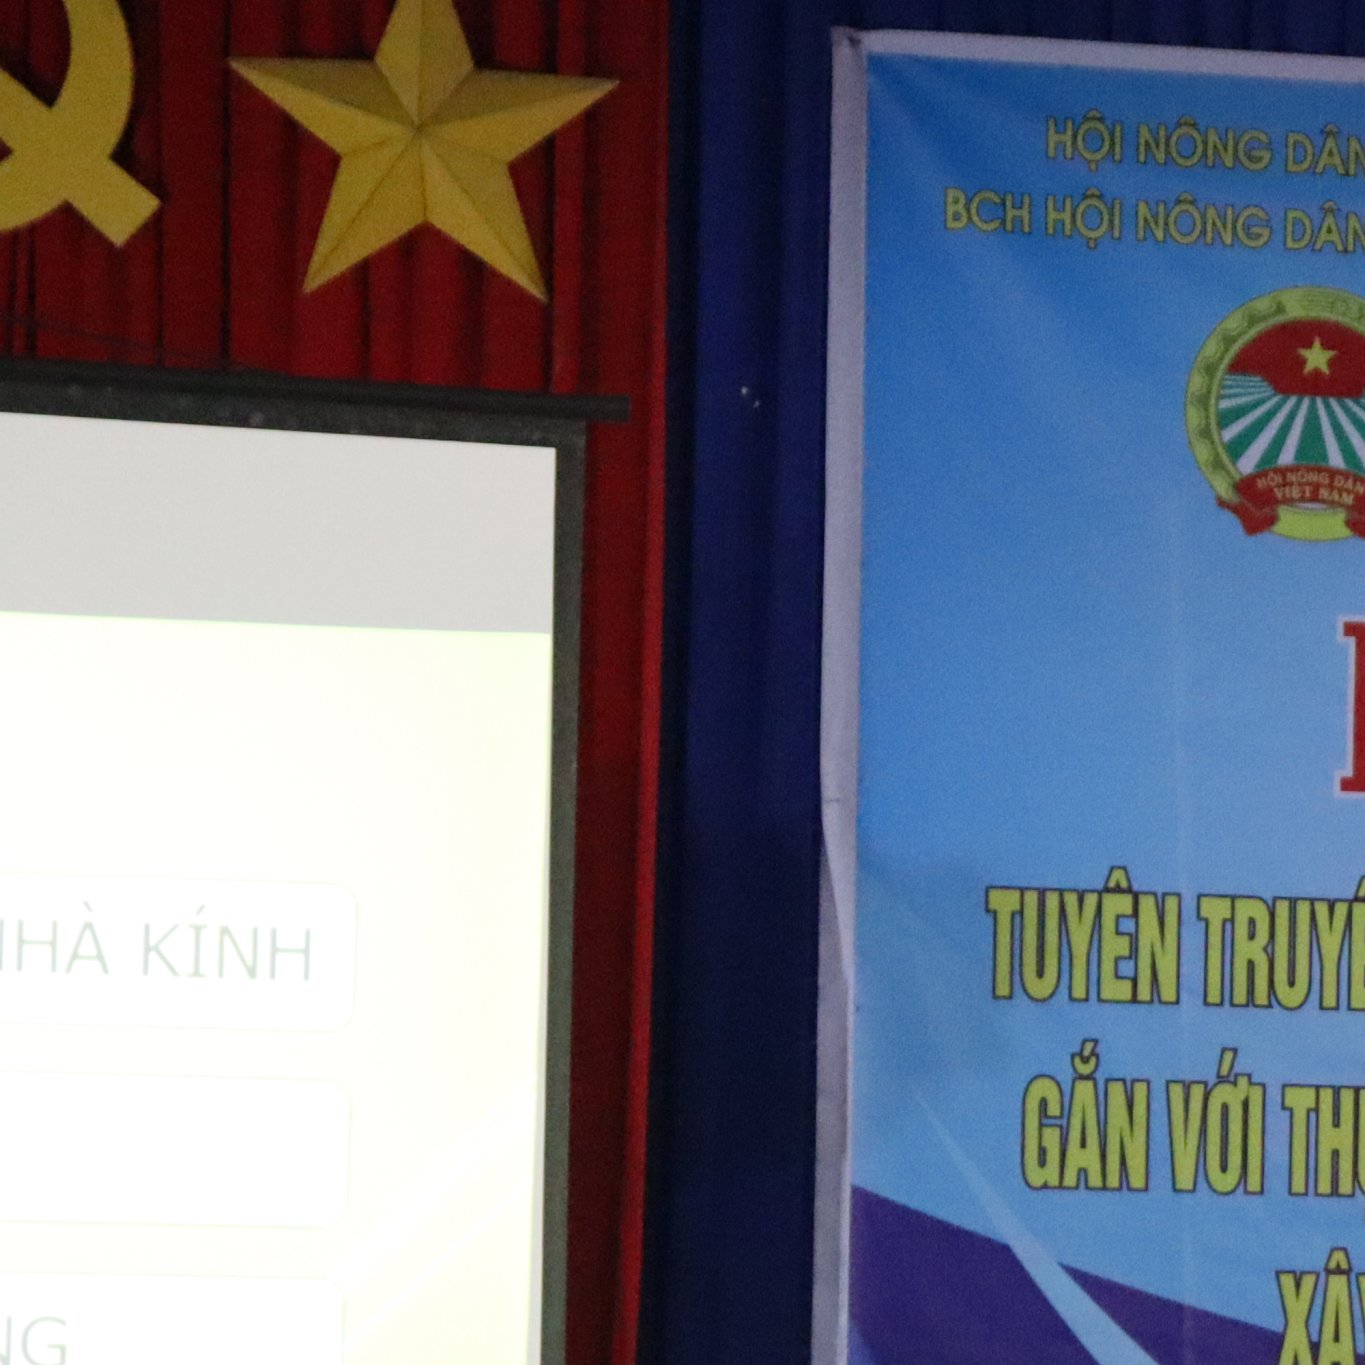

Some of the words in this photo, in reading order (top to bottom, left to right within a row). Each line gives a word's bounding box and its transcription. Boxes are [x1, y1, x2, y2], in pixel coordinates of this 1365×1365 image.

[1046, 108, 1121, 171] HỘI
[1137, 117, 1271, 173] NÔNG
[944, 188, 1030, 236] BCH
[1045, 188, 1120, 249] HỘI
[1137, 194, 1269, 249] NÔNG
[1319, 487, 1354, 505] NAM
[0, 900, 109, 975] HÀ
[143, 905, 311, 981] KÍNH
[985, 866, 1181, 1004] TUYÊN
[1020, 1039, 1149, 1191] GẮN
[1166, 1048, 1266, 1195] VỚI
